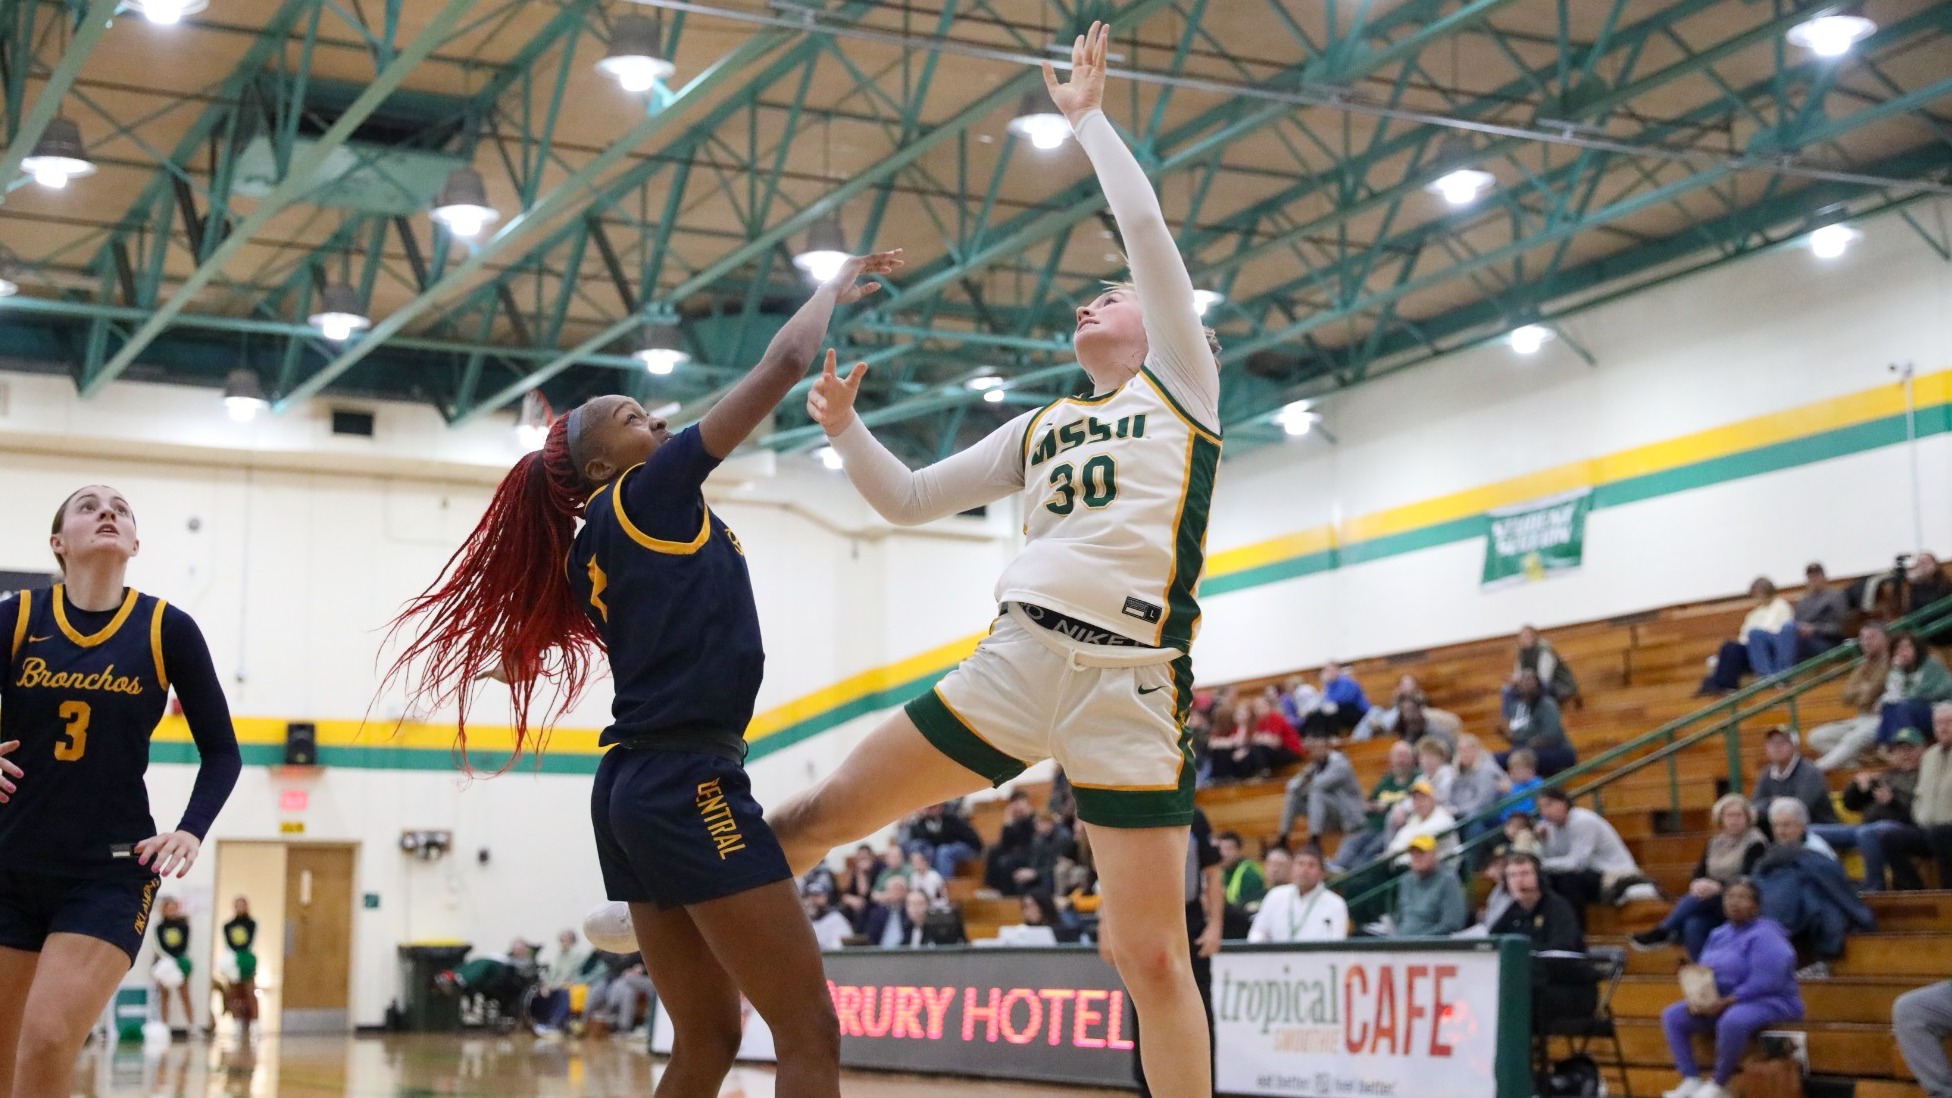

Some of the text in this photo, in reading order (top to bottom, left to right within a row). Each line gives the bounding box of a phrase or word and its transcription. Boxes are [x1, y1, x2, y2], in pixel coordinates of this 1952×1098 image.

[1045, 453, 1120, 516] 30
[16, 656, 143, 695] Bronchos
[54, 700, 91, 762] 3
[696, 777, 746, 860] CENTRAL
[826, 980, 1134, 1050] RURY HOTEL
[1220, 963, 1459, 1057] tropical CAFE
